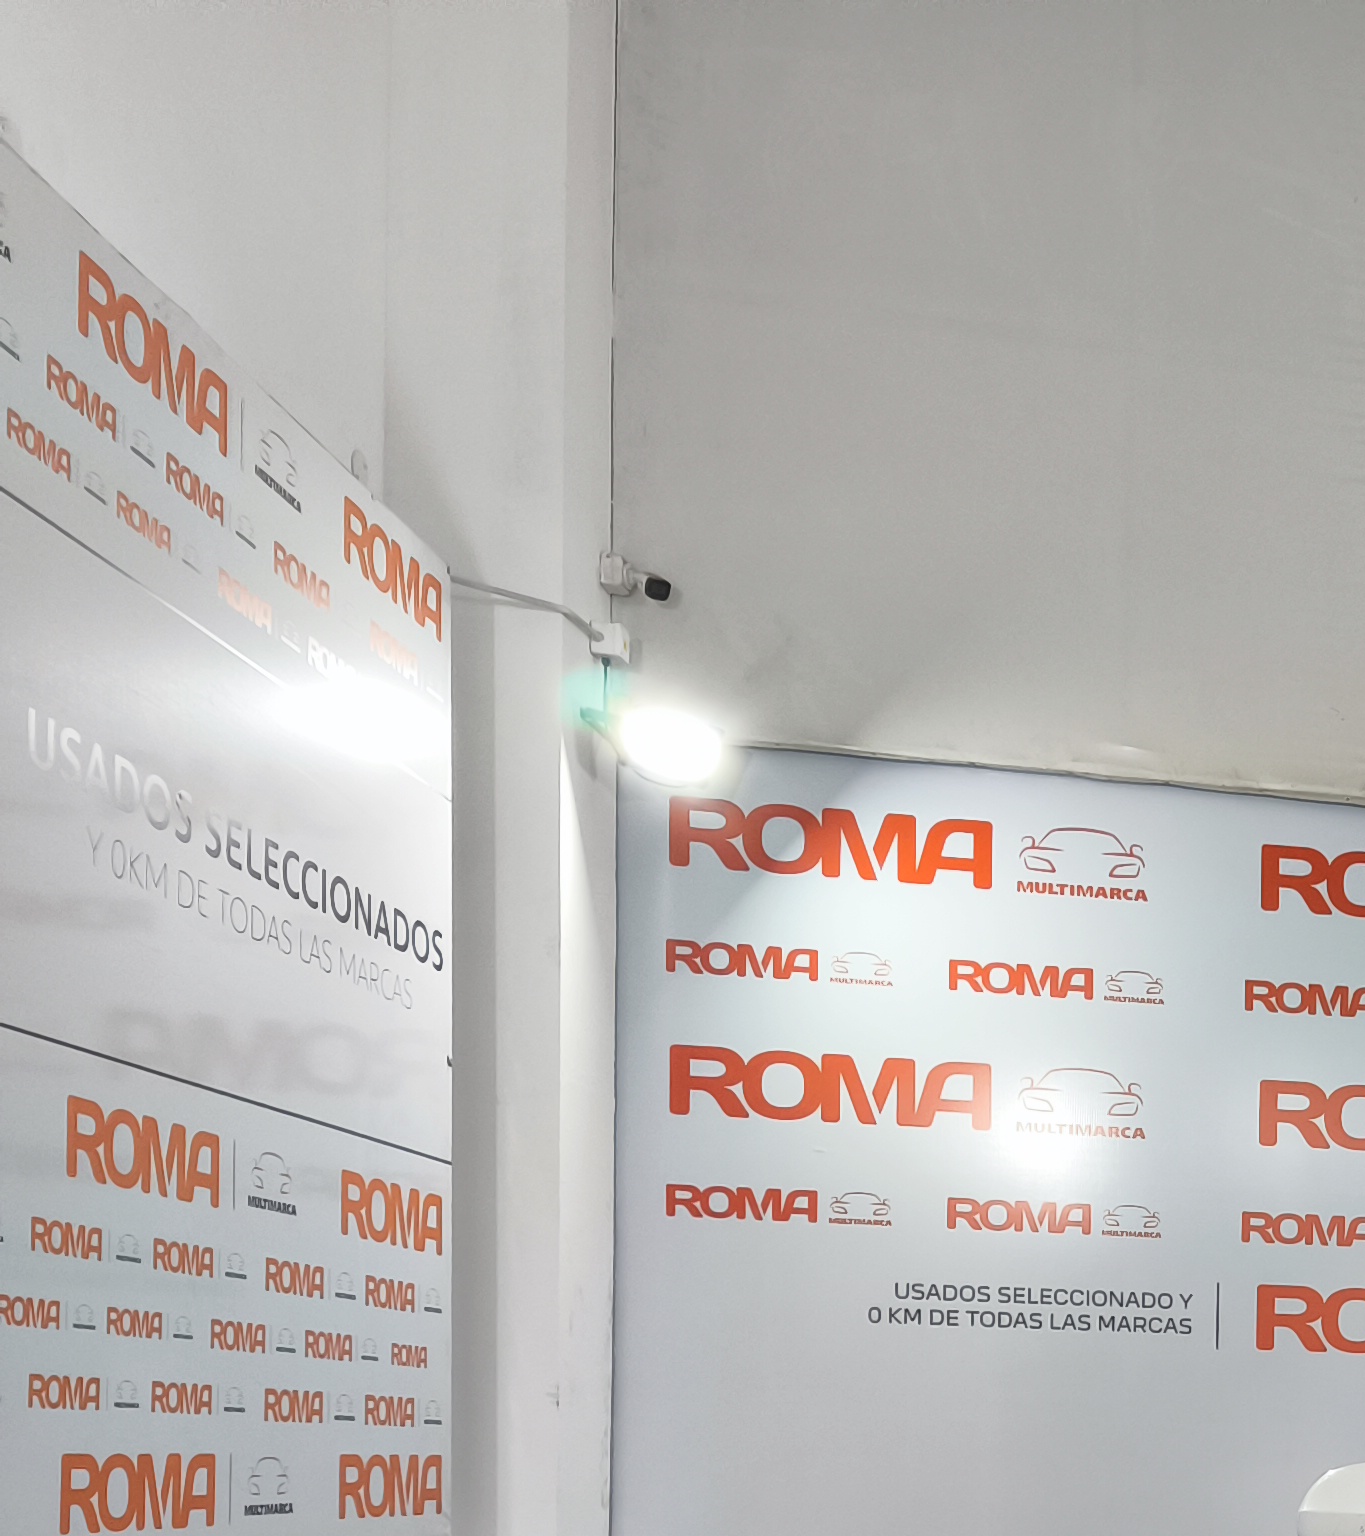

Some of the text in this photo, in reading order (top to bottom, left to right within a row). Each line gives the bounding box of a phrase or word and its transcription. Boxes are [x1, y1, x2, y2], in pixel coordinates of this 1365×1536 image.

[77, 250, 228, 457] ROMA
[46, 354, 117, 441] ROMA
[6, 407, 71, 482] ROMA
[166, 452, 224, 526] ROMA
[116, 490, 171, 555] ROMA
[273, 540, 331, 611] ROMA
[343, 495, 442, 642] ROMA
[27, 707, 445, 972] USADOS SELECCIONADOS
[668, 795, 993, 890] ROMA
[1016, 880, 1148, 902] MULTIMARCA
[86, 825, 105, 868] Y
[177, 868, 210, 918] DE
[217, 888, 293, 955] TODAS
[299, 929, 333, 973] LAS
[338, 946, 413, 1010] MARCAS
[665, 938, 819, 982] ROMA
[948, 959, 1095, 1001] ROMA
[669, 1043, 993, 1131] ROMA
[66, 1094, 220, 1209] ROMA
[1016, 1121, 1146, 1140] MULTIMARCA
[341, 1169, 443, 1256] ROMA
[665, 1183, 819, 1224] ROMA
[946, 1197, 1092, 1236] ROMA
[31, 1216, 103, 1261] ROMA
[153, 1237, 214, 1279] ROMA
[265, 1257, 325, 1299] ROMA
[365, 1275, 415, 1313] ROMA
[894, 1282, 1194, 1310] USADOS SELECCIONADO Y
[0, 1294, 61, 1330] ROMA
[106, 1306, 163, 1340] ROMA
[888, 1307, 922, 1326] KM
[929, 1308, 960, 1327] DE
[965, 1309, 1043, 1330] TODAS
[1049, 1312, 1091, 1332] LAS
[1098, 1314, 1193, 1335] MARCAS
[210, 1319, 266, 1354] ROMA
[304, 1330, 353, 1363] ROMA
[391, 1343, 428, 1369] ROMA
[27, 1373, 101, 1411] ROMA
[151, 1381, 213, 1416] ROMA
[263, 1388, 324, 1424] ROMA
[364, 1395, 415, 1428] ROMA
[59, 1453, 217, 1536] ROMA
[339, 1454, 443, 1520] ROMA
